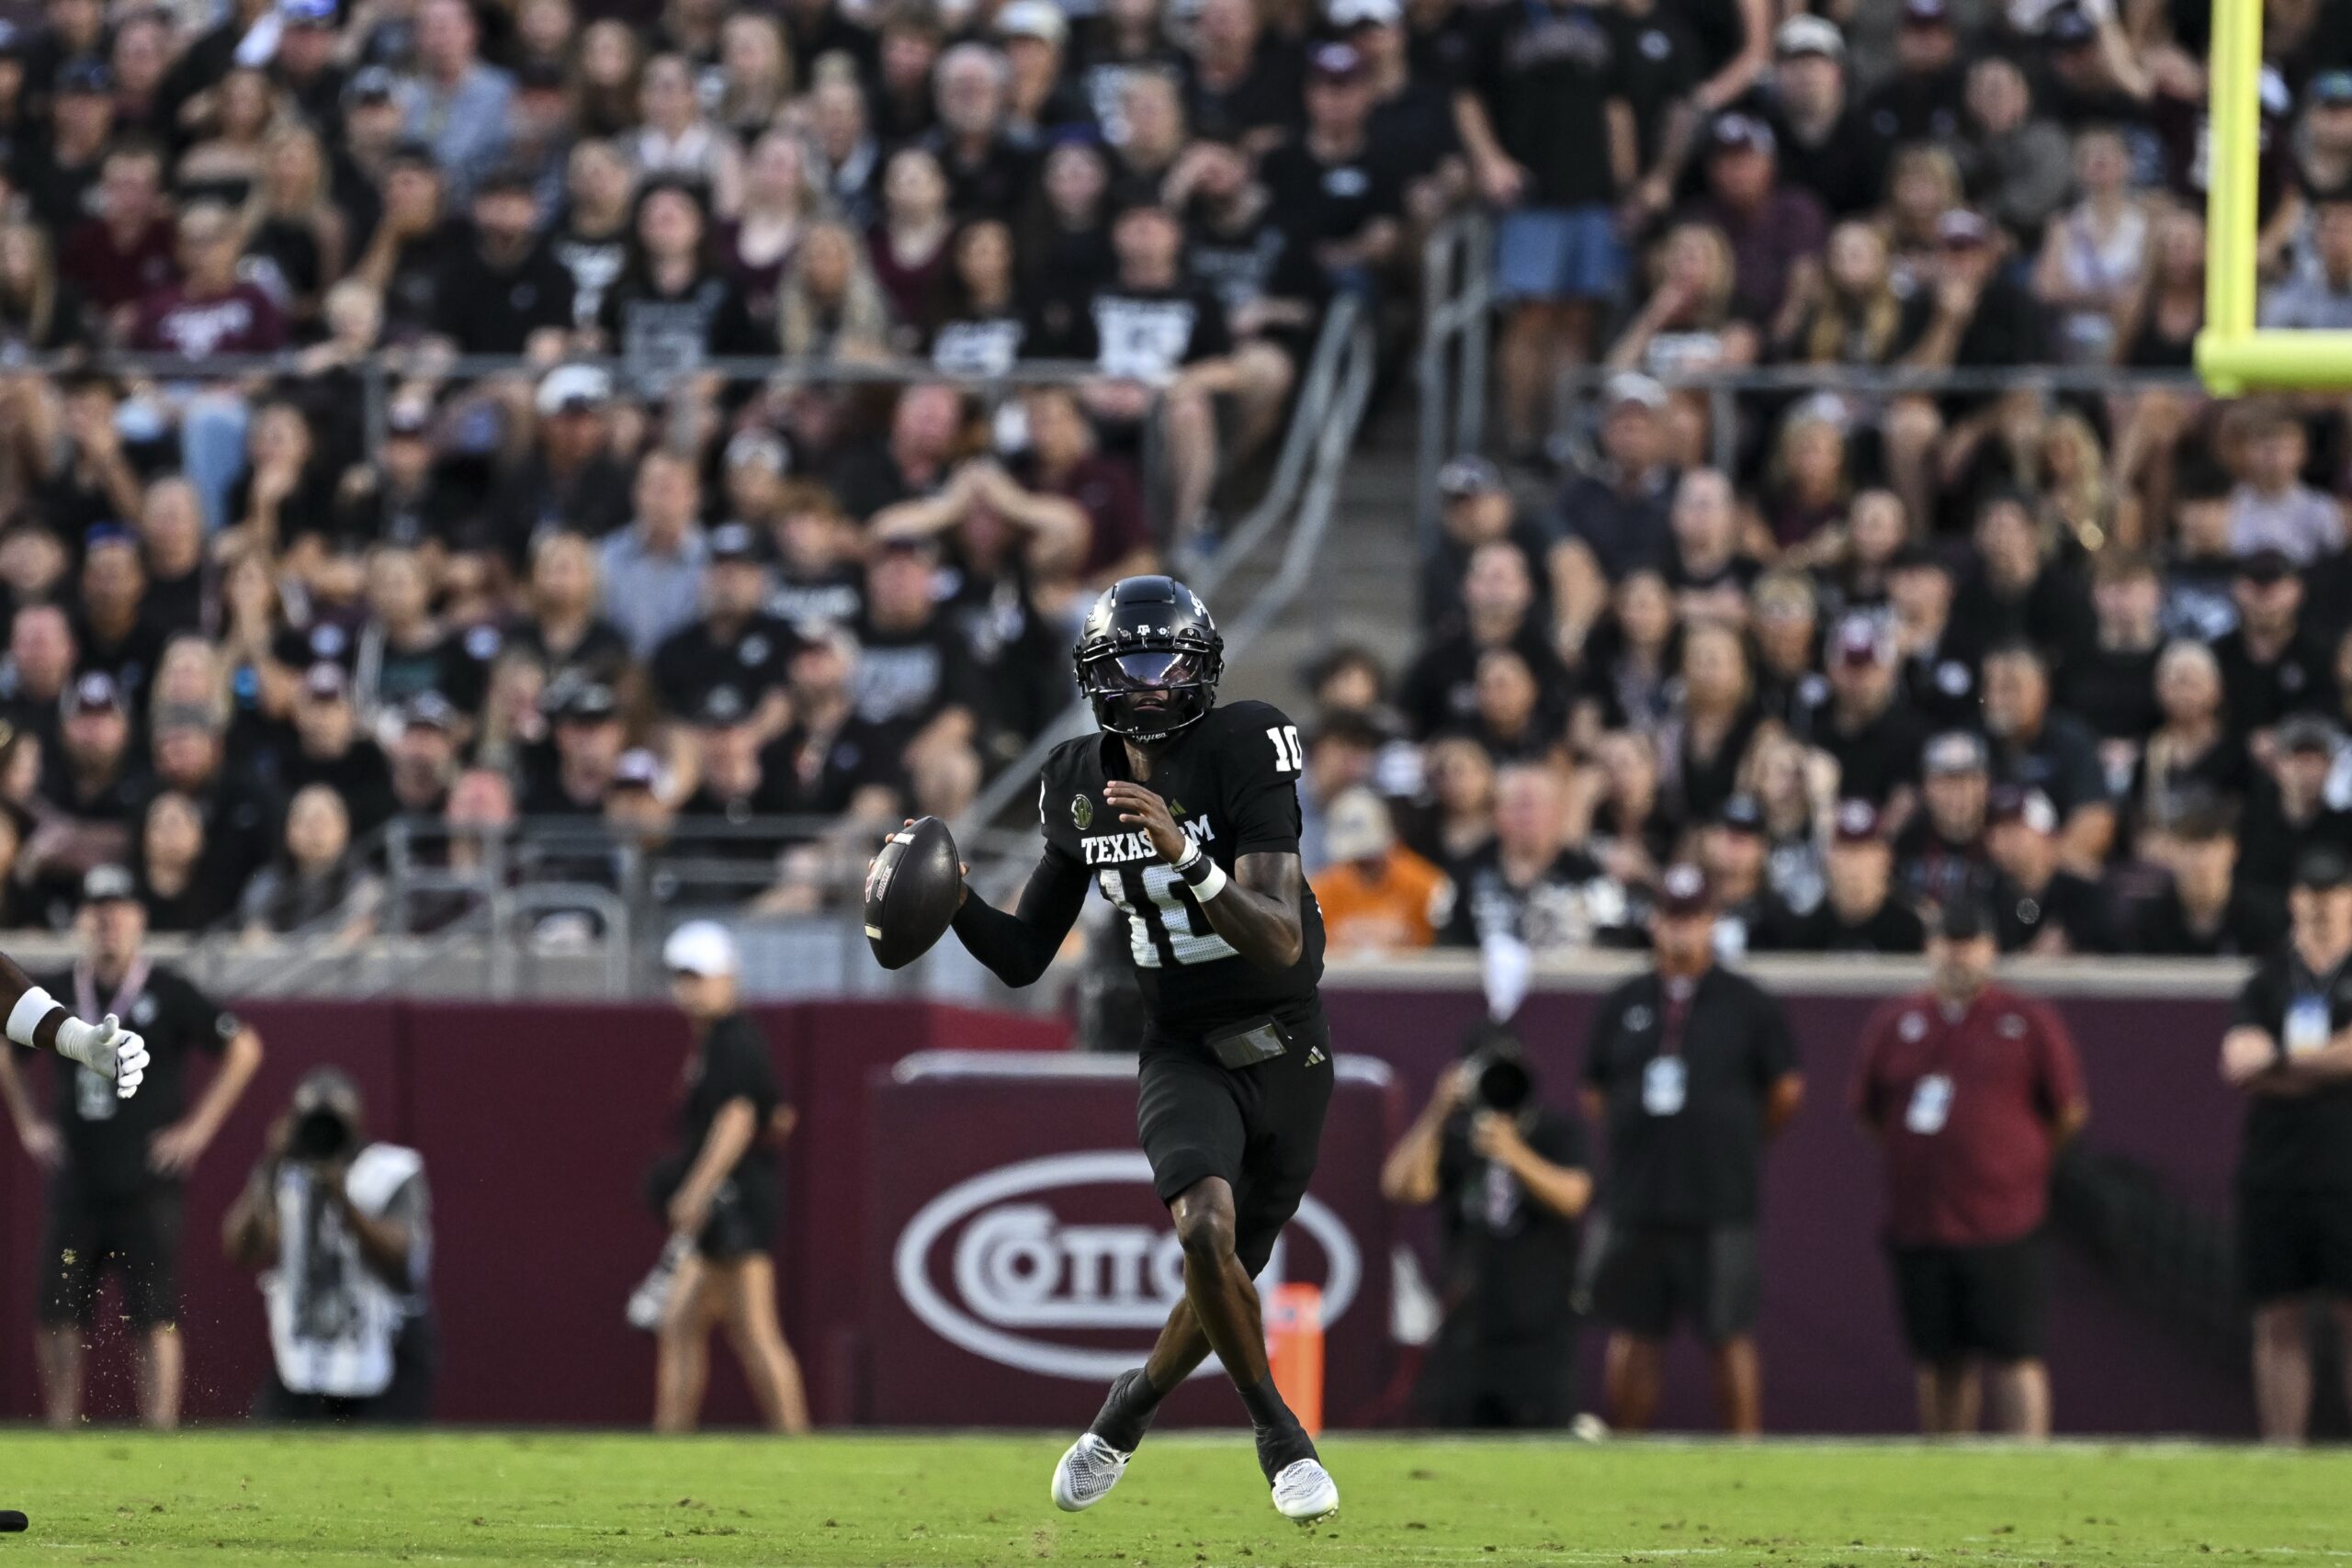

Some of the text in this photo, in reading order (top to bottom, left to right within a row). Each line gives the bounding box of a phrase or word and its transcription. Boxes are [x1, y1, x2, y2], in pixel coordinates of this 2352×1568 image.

[1266, 725, 1303, 773] 10
[1080, 830, 1159, 865] TEXAS
[1099, 863, 1240, 968] 10
